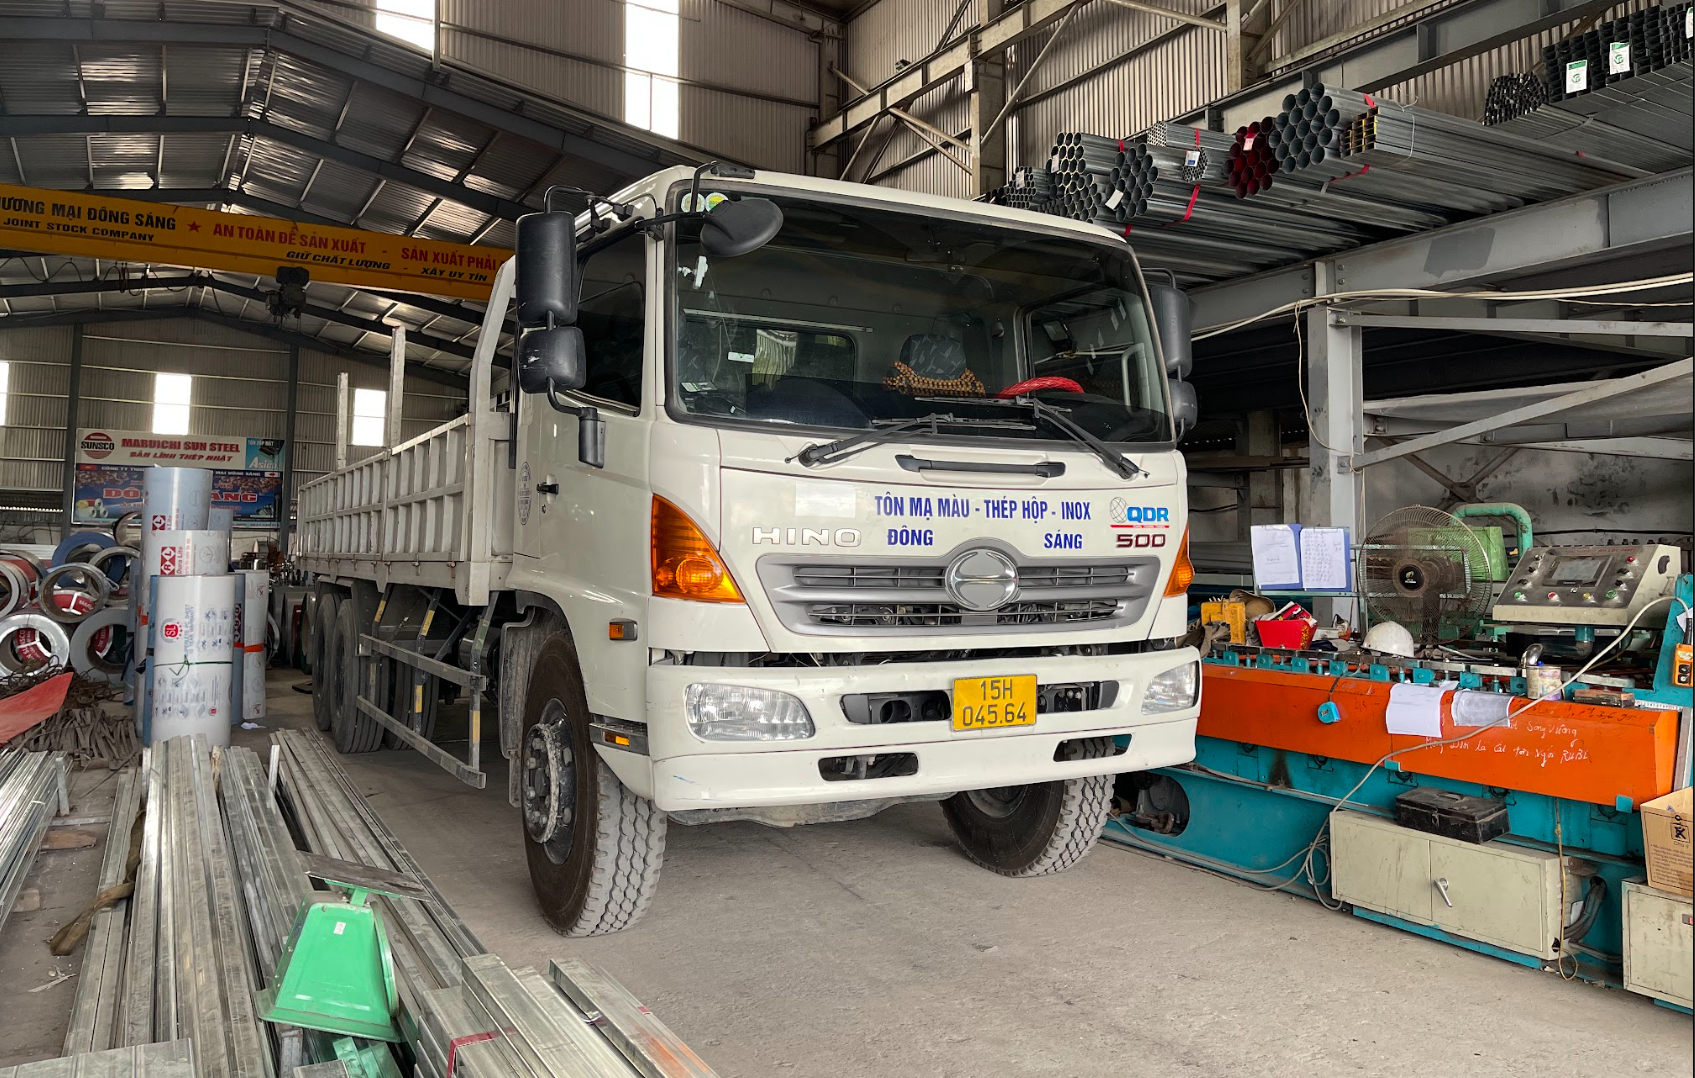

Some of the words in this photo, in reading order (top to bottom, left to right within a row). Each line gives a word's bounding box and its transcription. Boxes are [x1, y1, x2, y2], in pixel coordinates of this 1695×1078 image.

[0, 196, 45, 214] ƯƠNG
[52, 203, 82, 221] MẠI
[87, 206, 130, 224] ĐÔNG
[135, 208, 176, 230] SÁNG
[3, 218, 42, 229] JOINT
[46, 222, 87, 234] STOCK
[92, 227, 155, 242] COMPANY
[213, 223, 234, 238] AN
[238, 226, 275, 242] TOÀN
[300, 231, 328, 249] SẢN
[331, 236, 366, 254] XUẤT
[401, 245, 428, 262] SẢN
[432, 250, 464, 267] XUẤT
[467, 254, 496, 270] PHẢI
[312, 254, 346, 265] CHẤT
[348, 258, 391, 270] LƯỢNG
[469, 273, 488, 281] TÍN
[81, 441, 114, 450] SUNSCO
[121, 438, 180, 450] MARUICHI
[183, 441, 206, 451] SUN
[209, 442, 240, 453] STEEL
[103, 486, 142, 499] ĐÔ
[211, 489, 258, 502] ÁNG
[874, 492, 904, 516] TÔN
[910, 497, 933, 521] MẠ
[937, 494, 970, 518] MÀU
[984, 496, 1017, 519] THÉP
[1022, 496, 1048, 524] HỘP
[1061, 501, 1091, 520] INOX
[1127, 507, 1169, 523] QDR
[752, 527, 862, 547] HINO
[887, 525, 933, 546] ĐÔNG
[1044, 530, 1082, 549] SÁNG
[1116, 534, 1166, 548] 500
[166, 626, 176, 636] SL
[980, 679, 1012, 701] 15H
[962, 702, 1026, 726] 045.64
